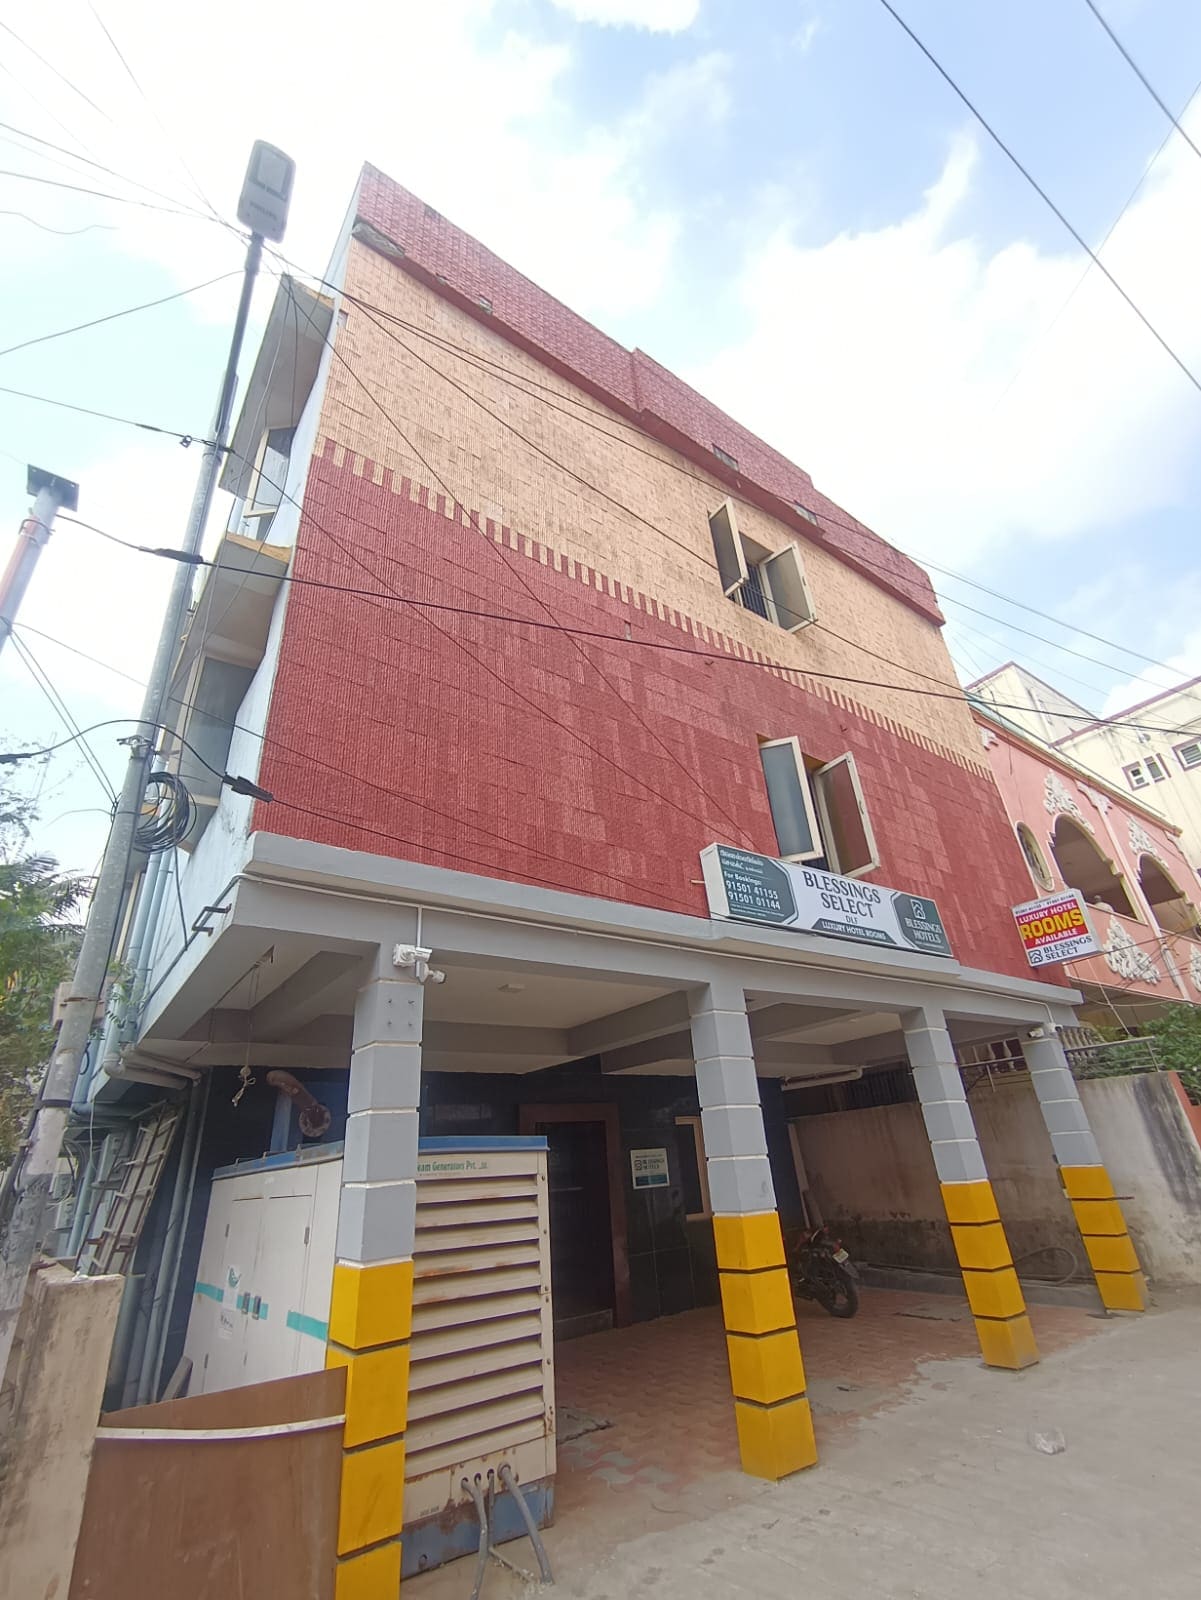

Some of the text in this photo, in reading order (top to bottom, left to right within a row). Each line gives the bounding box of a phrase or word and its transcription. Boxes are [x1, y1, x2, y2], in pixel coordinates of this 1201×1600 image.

[726, 880, 778, 900] 91501 41155
[802, 870, 881, 904] BLESSINGS
[728, 891, 753, 905] 91501
[756, 897, 781, 910] 01144
[821, 892, 874, 918] SELECT
[1019, 910, 1049, 924] LUXURY
[1050, 901, 1077, 915] HOTEL
[821, 921, 846, 932] LUXURY
[846, 925, 865, 937] HOTEL
[904, 917, 942, 934] BLESSINGS
[1020, 908, 1084, 940] ROOMS
[913, 930, 941, 944] HOTELS
[1035, 928, 1078, 945] AVAILABLE
[1043, 935, 1092, 954] BLESSINGS
[1045, 947, 1079, 961] SELECT
